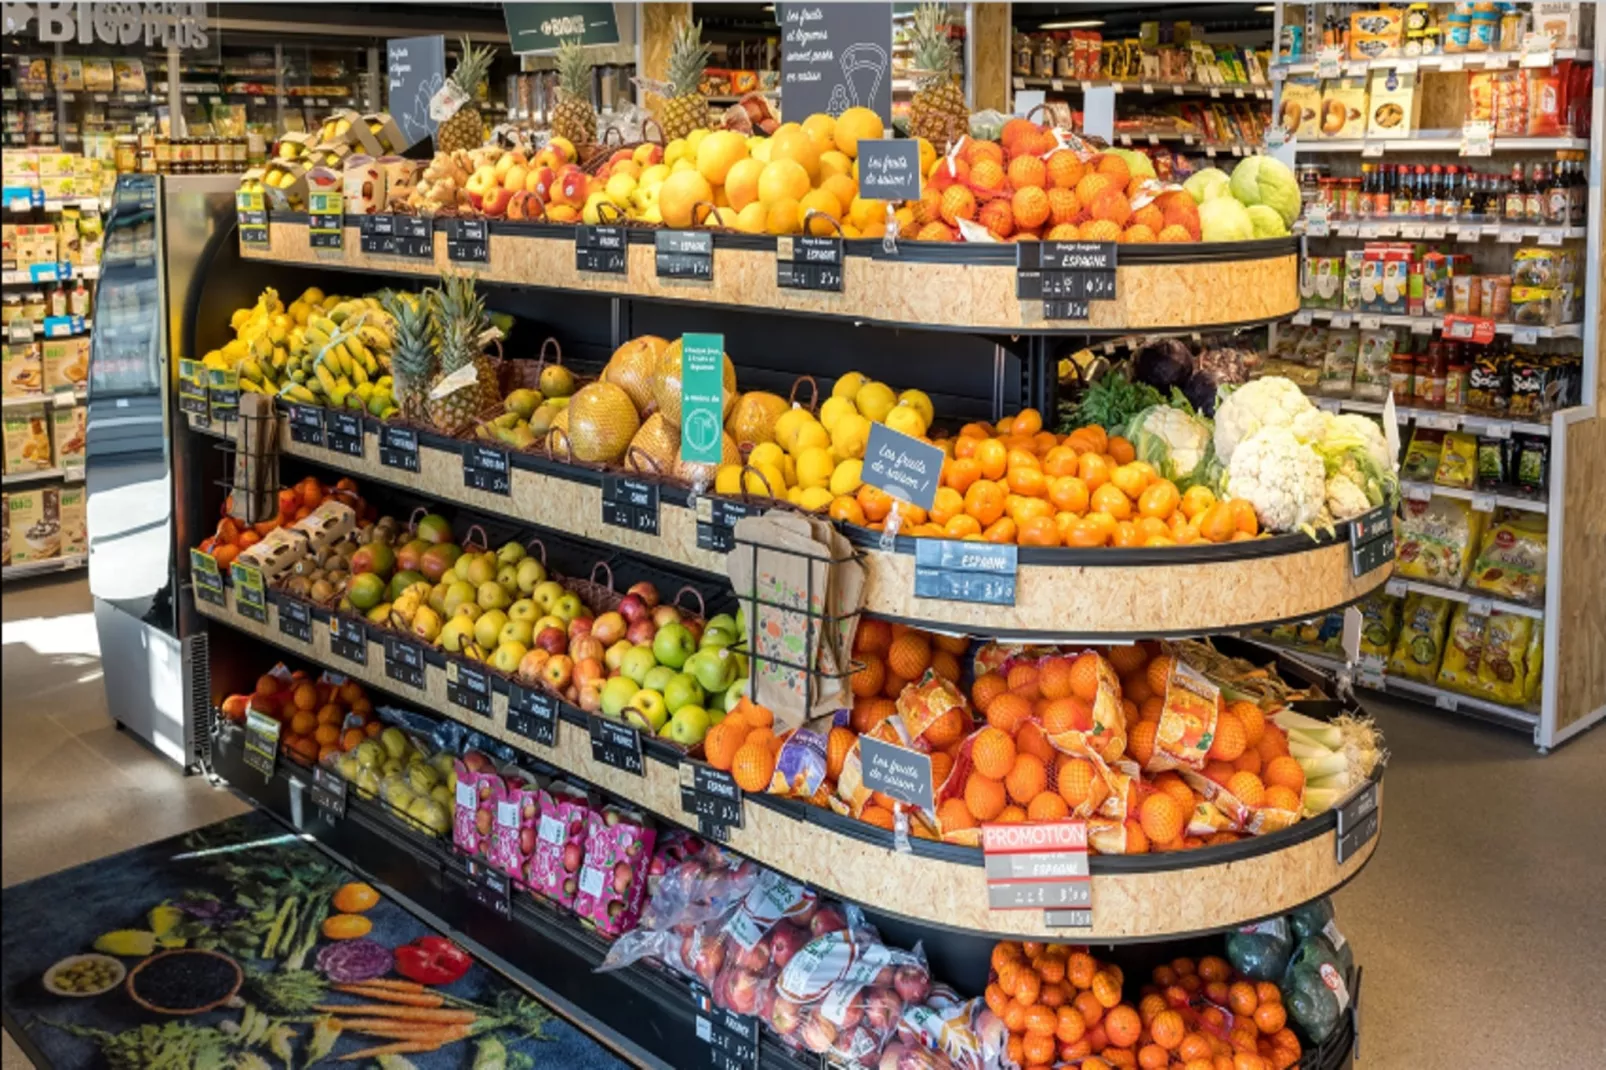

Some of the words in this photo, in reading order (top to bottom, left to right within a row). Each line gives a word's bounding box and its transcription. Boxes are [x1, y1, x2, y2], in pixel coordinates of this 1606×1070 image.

[868, 155, 882, 168] Les
[882, 154, 908, 174] fruits
[864, 172, 877, 185] de
[877, 175, 905, 186] saison
[1061, 255, 1107, 268] ESPAGNE
[878, 443, 896, 461] Les
[894, 451, 926, 475] fruits
[871, 460, 885, 474] de
[885, 467, 918, 490] saison
[872, 753, 889, 769] Les
[888, 759, 919, 779] fruits
[868, 767, 883, 781] de
[883, 775, 916, 792] saison
[986, 825, 1085, 846] PROMOTION
